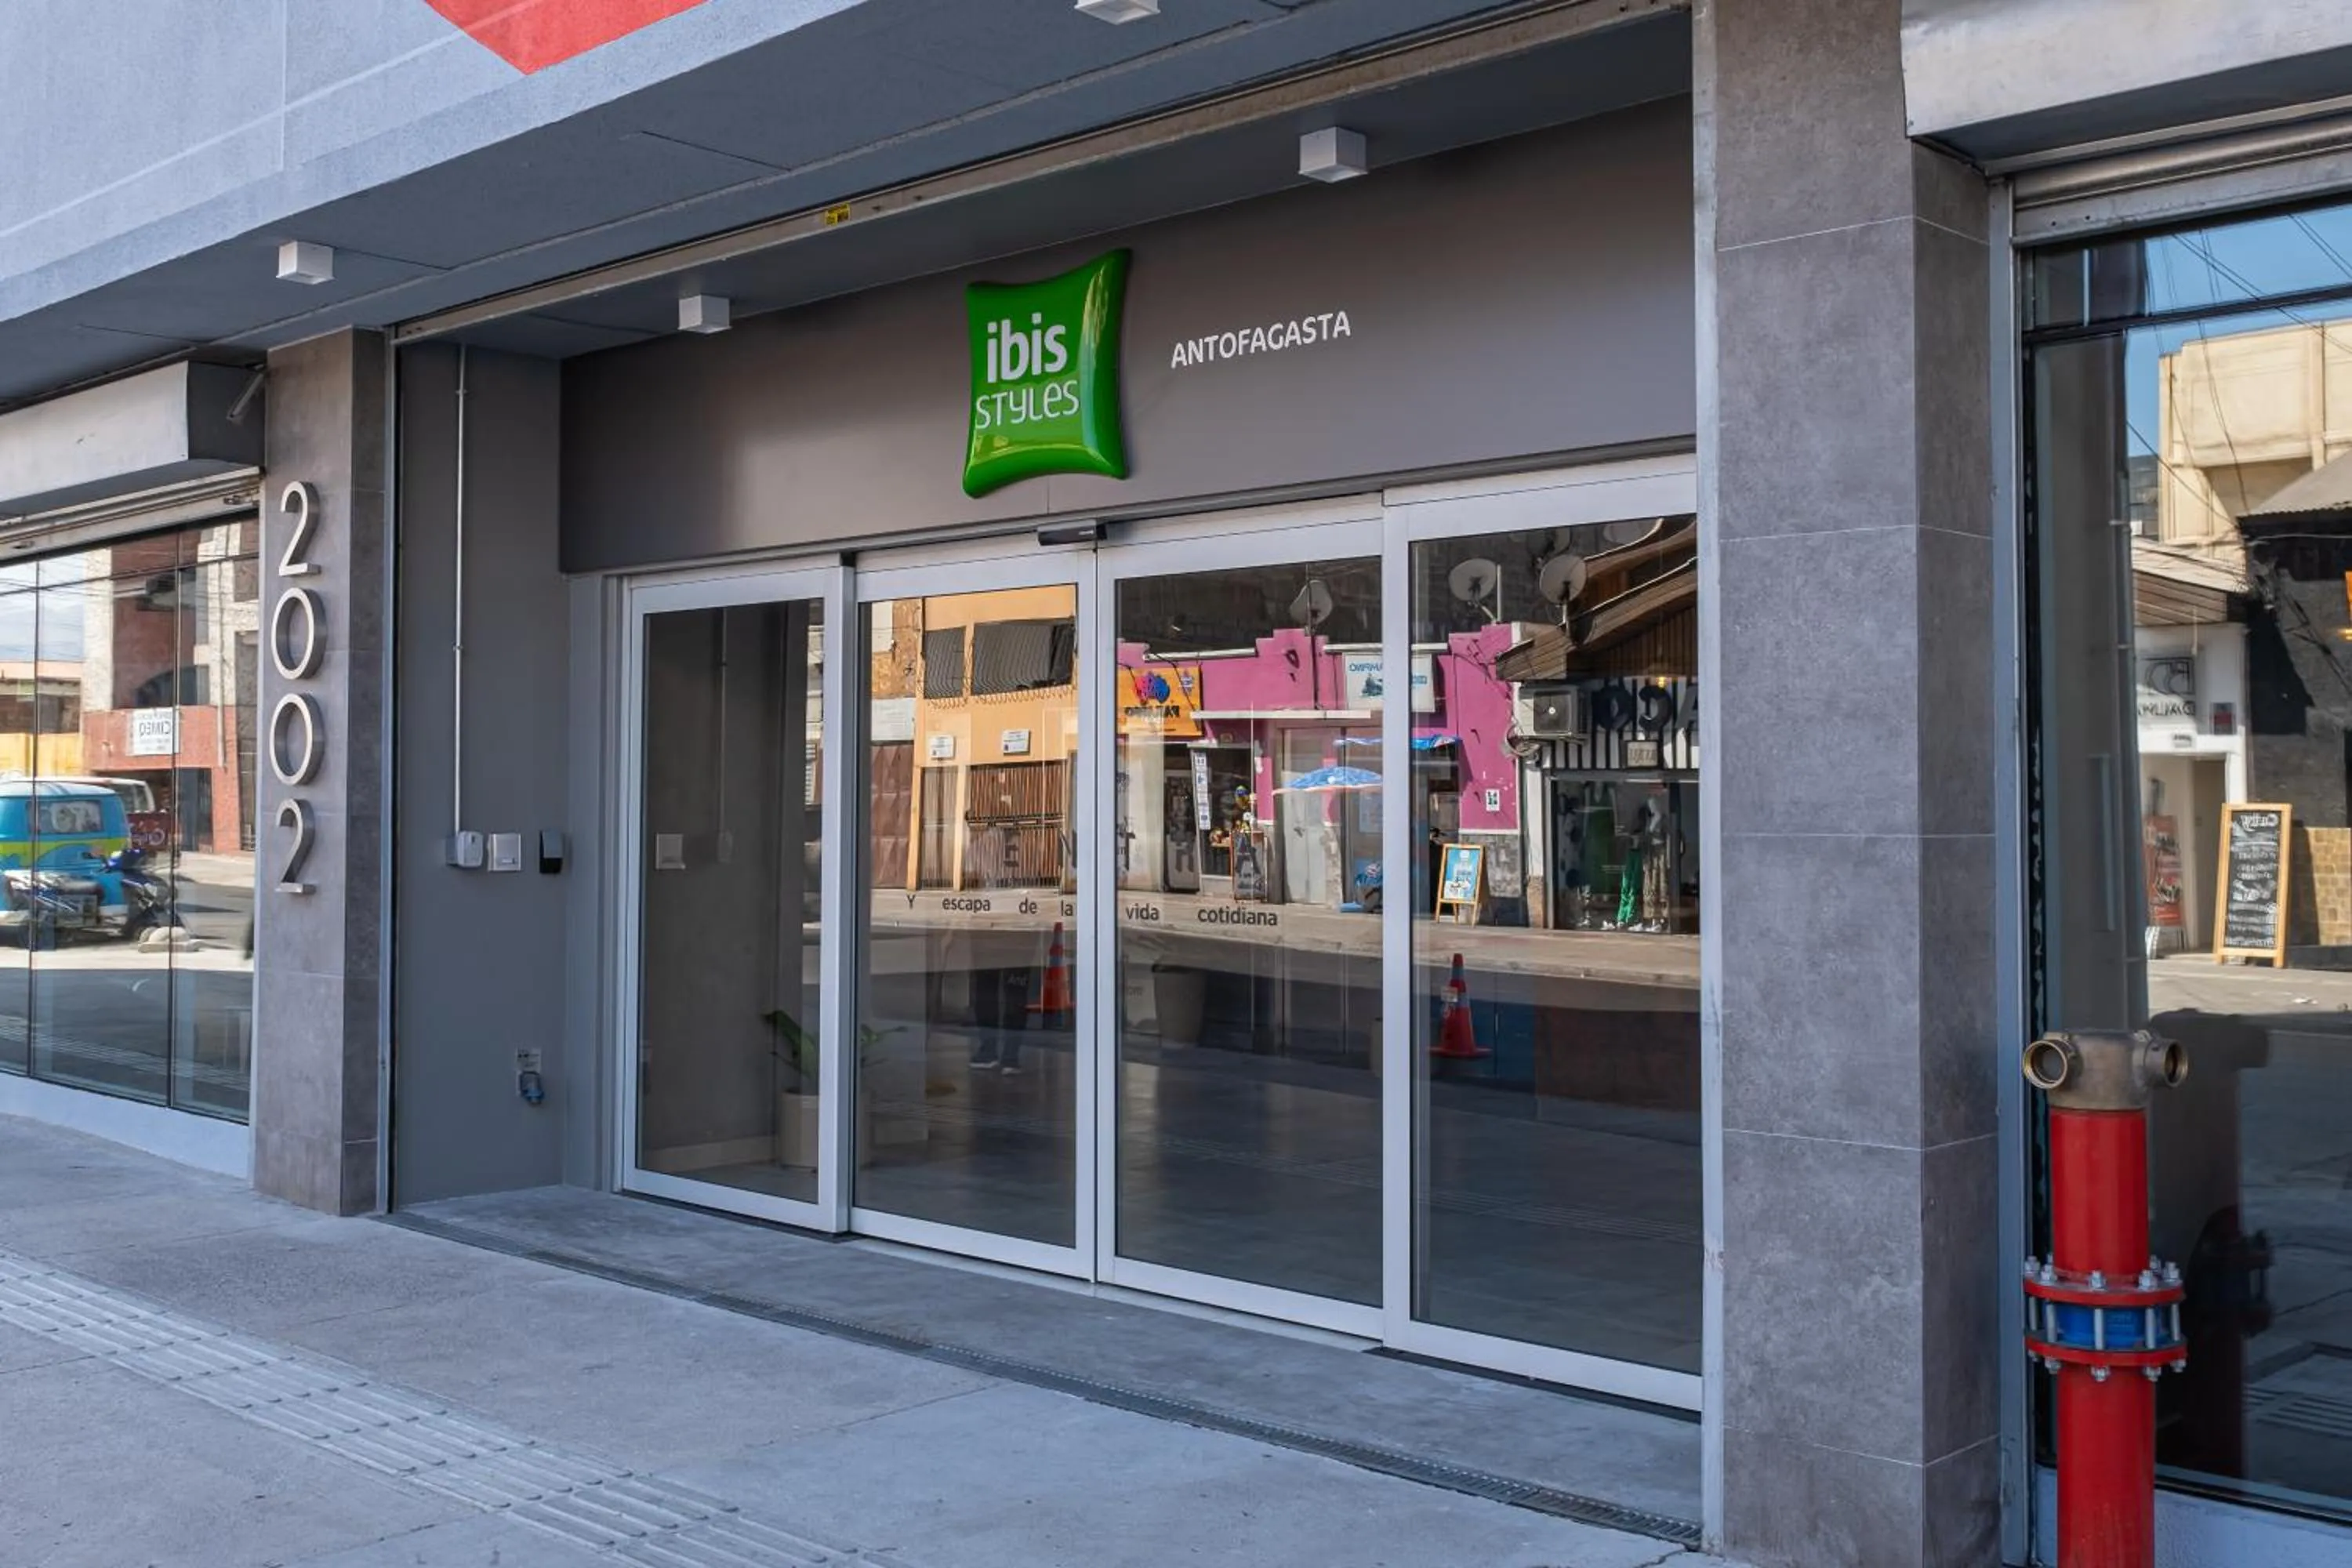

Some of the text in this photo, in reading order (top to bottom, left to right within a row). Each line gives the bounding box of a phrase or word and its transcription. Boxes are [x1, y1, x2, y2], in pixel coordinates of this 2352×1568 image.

[987, 312, 1068, 383] ibis
[1171, 310, 1352, 368] ANTOFAGASTA
[269, 480, 326, 894] 2002
[906, 895, 1278, 926] Y escapa de la vida cotidiana
